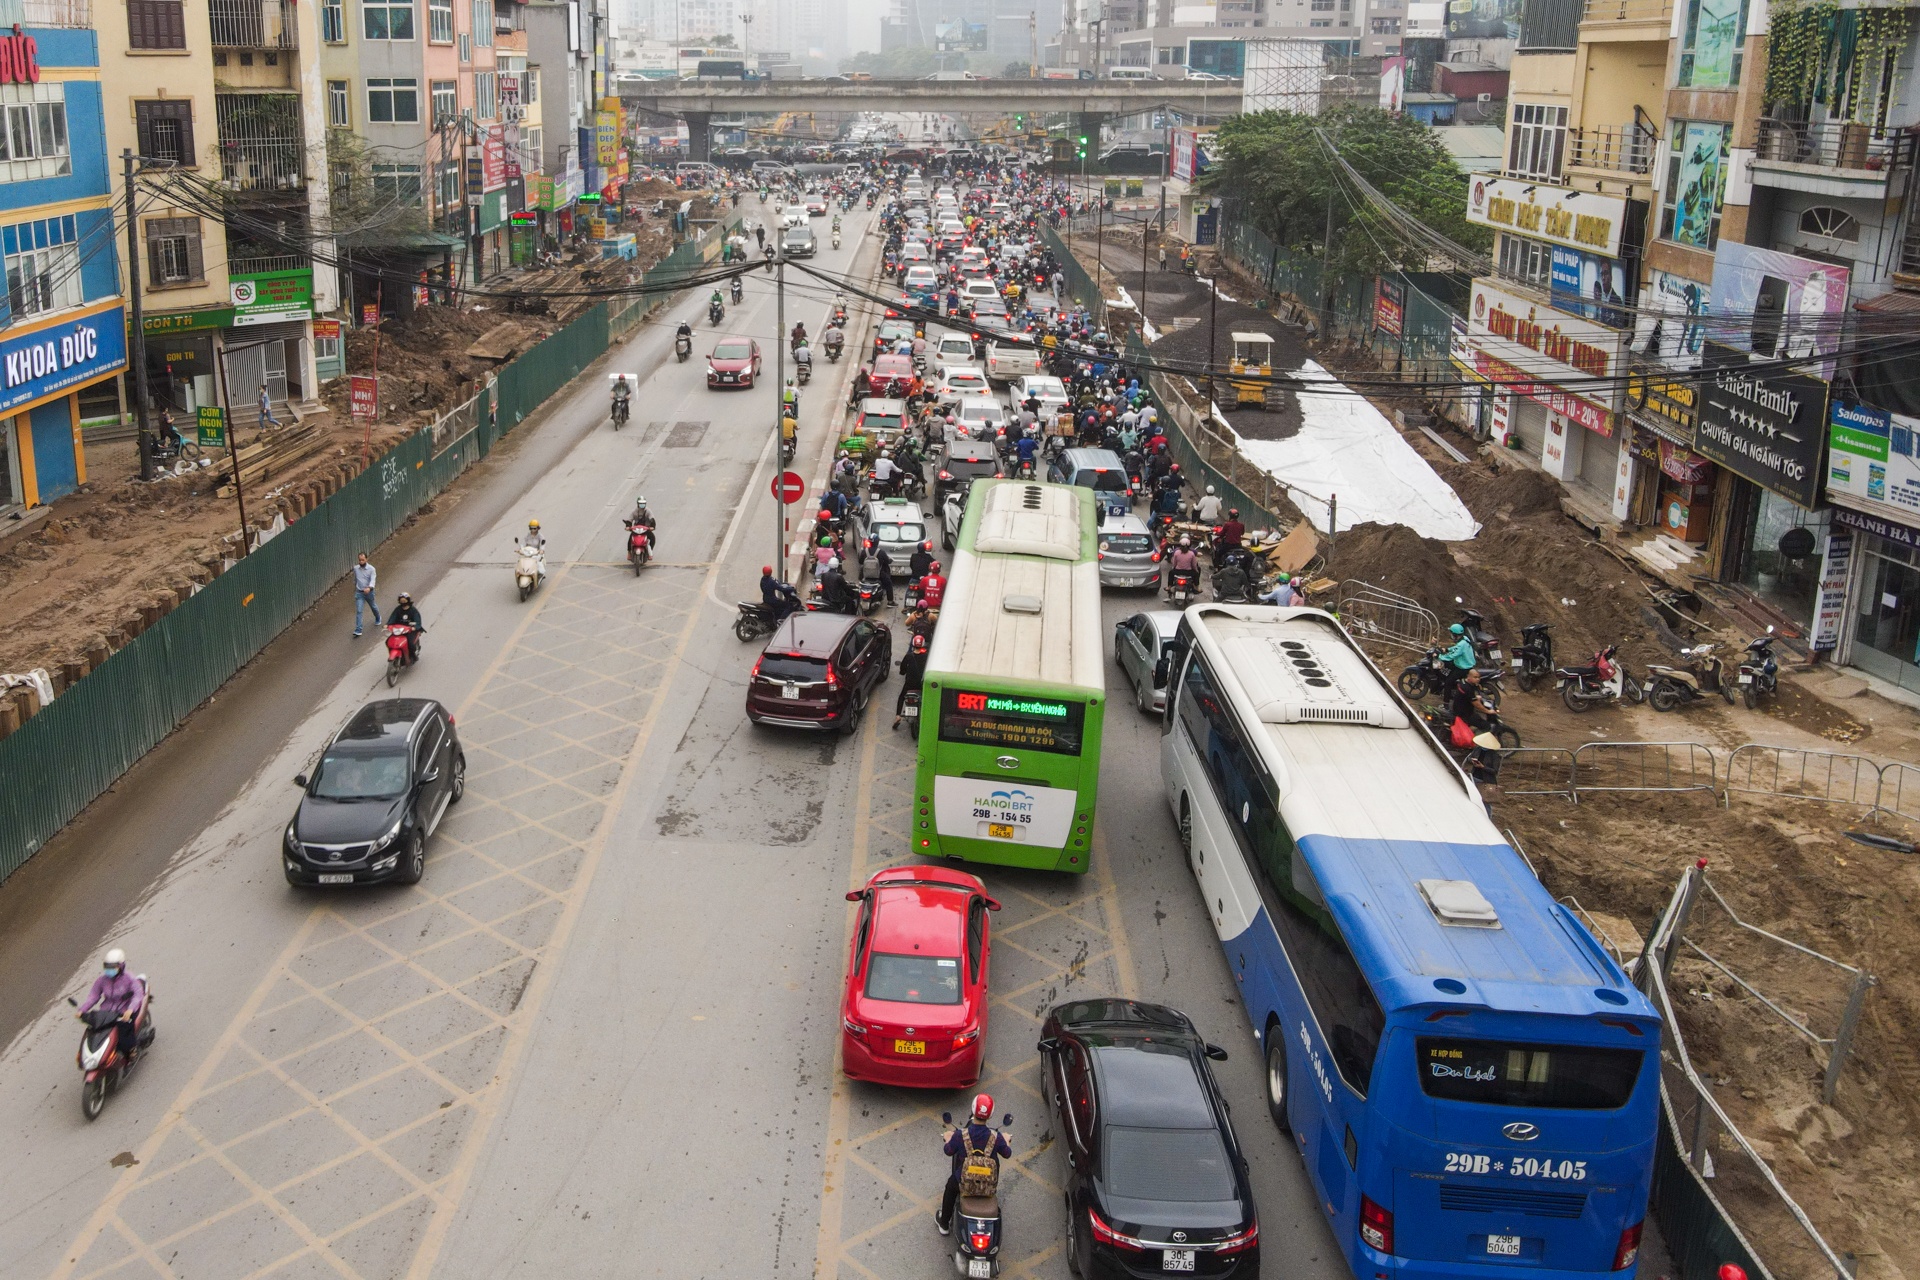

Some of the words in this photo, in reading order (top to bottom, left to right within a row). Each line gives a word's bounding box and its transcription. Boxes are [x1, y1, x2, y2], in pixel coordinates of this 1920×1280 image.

[502, 79, 519, 90] KALI
[5, 340, 58, 389] KHOA
[1753, 380, 1800, 424] Family
[199, 417, 223, 428] NGON
[1567, 399, 1576, 418] 10
[1581, 405, 1599, 429] 20%
[1837, 407, 1885, 428] Salonpas
[206, 429, 217, 438] TH
[1700, 421, 1732, 448] CHUYÊN
[1732, 436, 1749, 456] GIA
[1749, 444, 1781, 472] NGÀNH
[1783, 458, 1804, 481] TÓC
[1835, 433, 1882, 454] Hisamitsu
[1835, 508, 1886, 536] KHÁNH
[1889, 525, 1911, 545] HÀ
[958, 693, 987, 711] BRT
[987, 699, 1001, 709] KIM
[983, 721, 997, 729] BUS
[1002, 733, 1027, 743] 1900
[1030, 736, 1055, 746] 1296
[1012, 801, 1034, 812] BRT
[972, 808, 991, 819] 29B
[1000, 811, 1019, 822] 154
[1020, 814, 1032, 824] 55
[1431, 1049, 1438, 1057] XE
[1444, 1152, 1491, 1175] 29B
[1509, 1157, 1587, 1181] 504.05
[1163, 1260, 1194, 1271] 857.45
